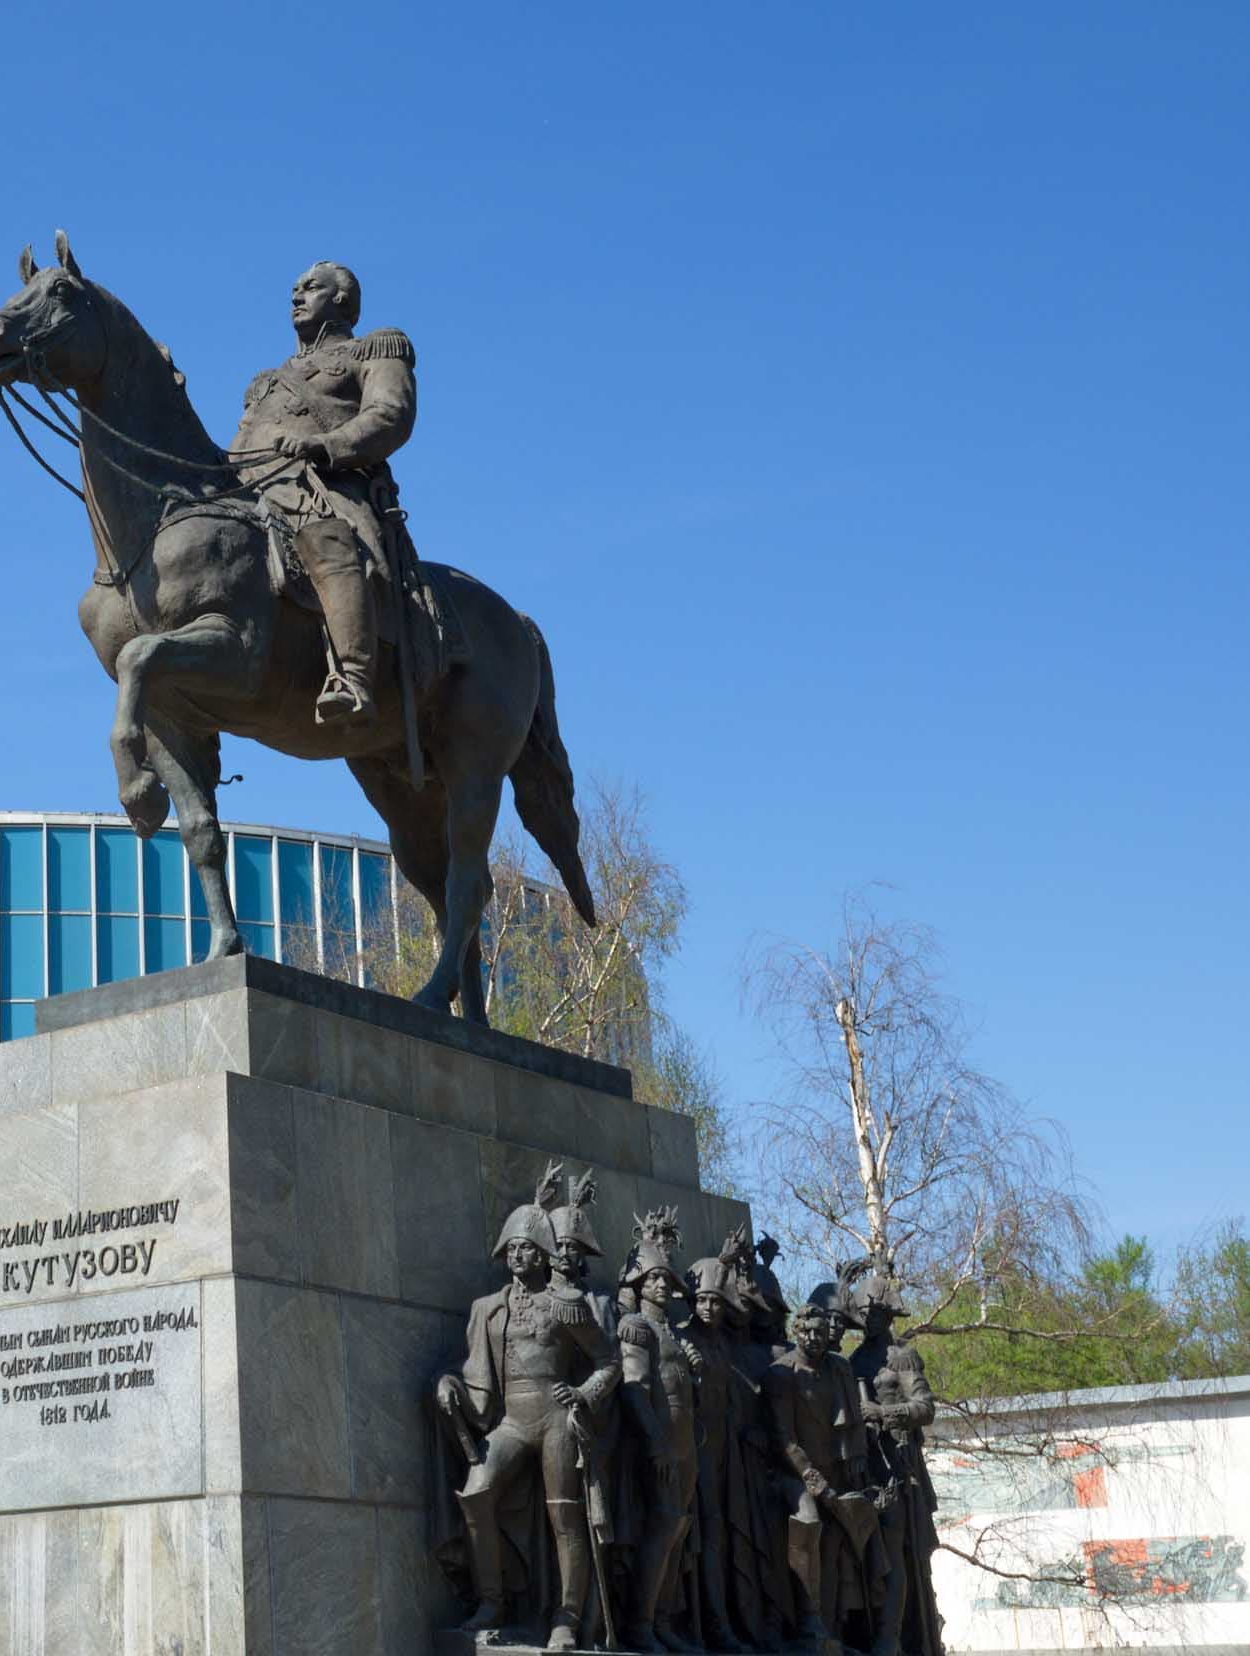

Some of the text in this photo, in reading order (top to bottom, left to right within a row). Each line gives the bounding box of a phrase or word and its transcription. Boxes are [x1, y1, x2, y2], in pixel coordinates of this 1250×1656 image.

[53, 1198, 180, 1240] ИЛЛАРИОНОВИЧУ
[3, 1239, 157, 1294] КУТУЗОВУ
[27, 1323, 71, 1348] СЫНАМ
[73, 1317, 140, 1344] РУССКОГО
[0, 1339, 153, 1380] ОДЕРЖАВШИМ ПОБЕДУ
[2, 1367, 155, 1405] В ОТЕЧЕСТВЕННОЙ ВОЙНЕ
[40, 1403, 67, 1426] 1812
